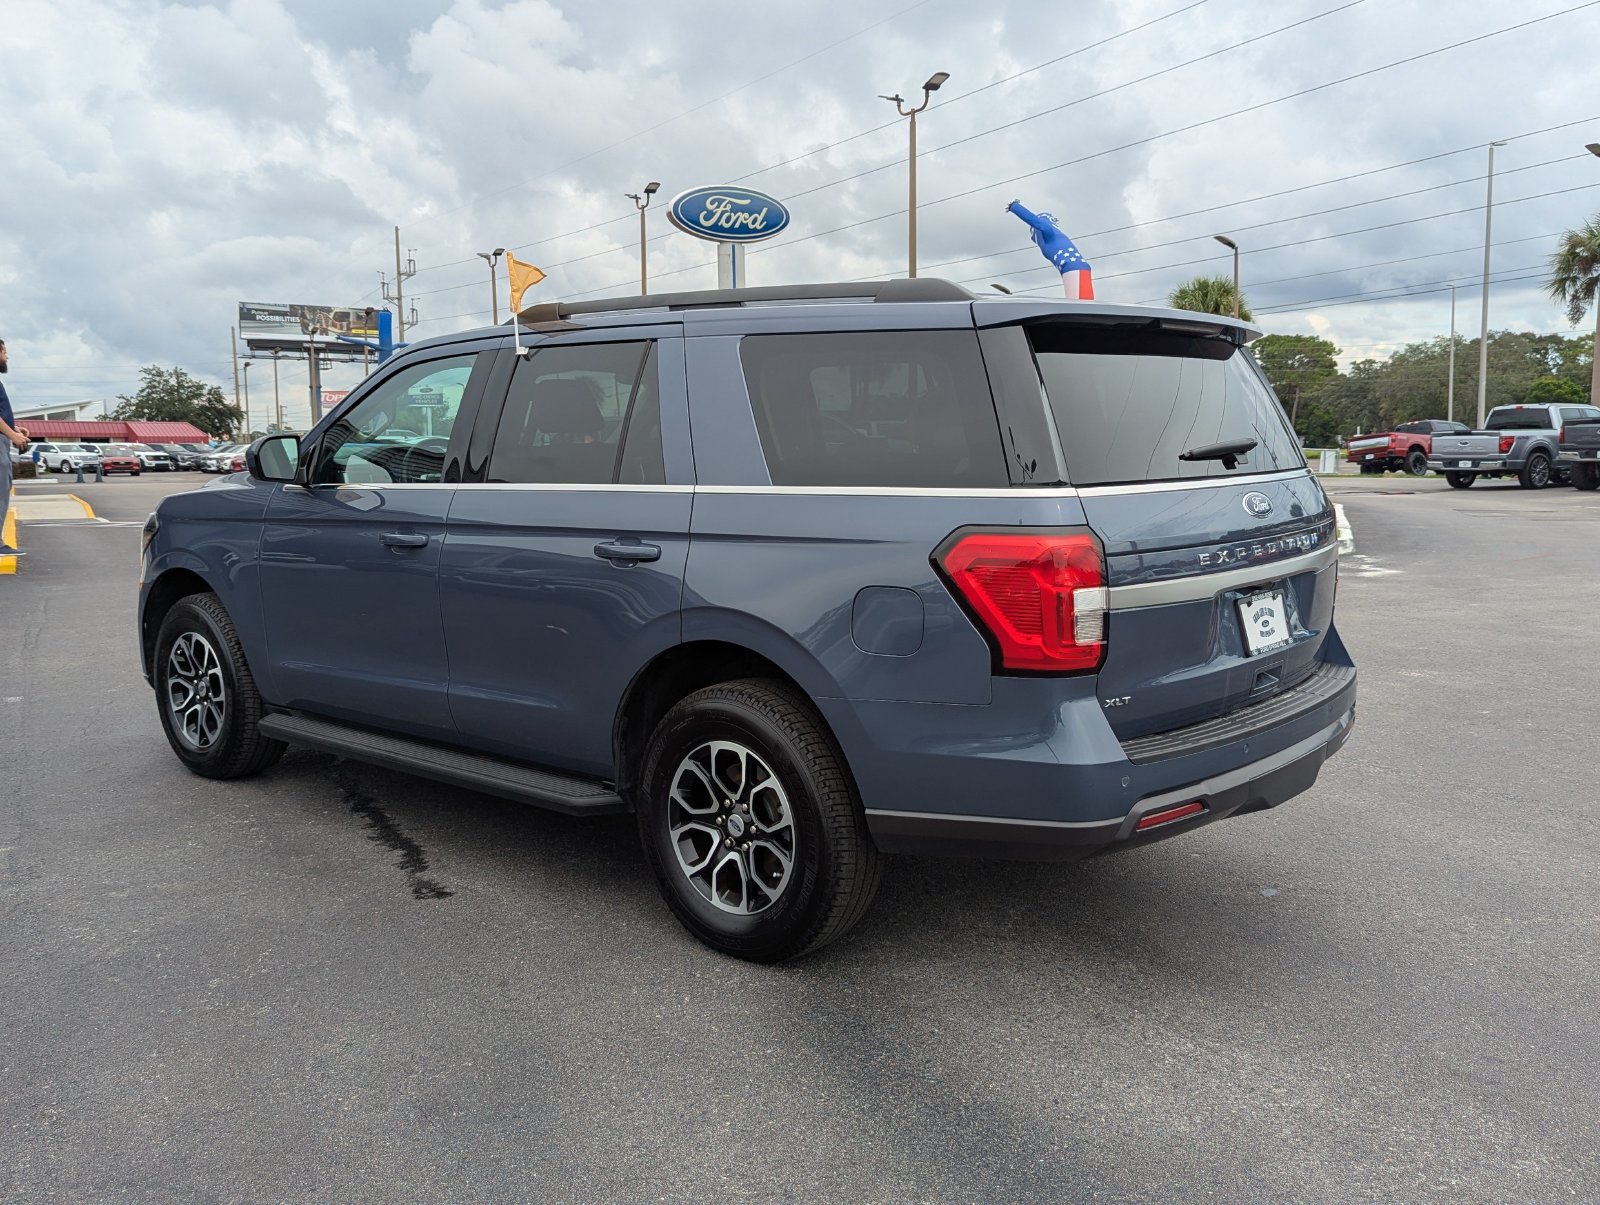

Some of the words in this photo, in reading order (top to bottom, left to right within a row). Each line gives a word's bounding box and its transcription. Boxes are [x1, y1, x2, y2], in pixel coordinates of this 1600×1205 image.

[699, 195, 769, 230] Ford
[1251, 496, 1270, 512] Ford
[1197, 532, 1319, 567] EXPEDITION
[1104, 696, 1132, 708] XLT
